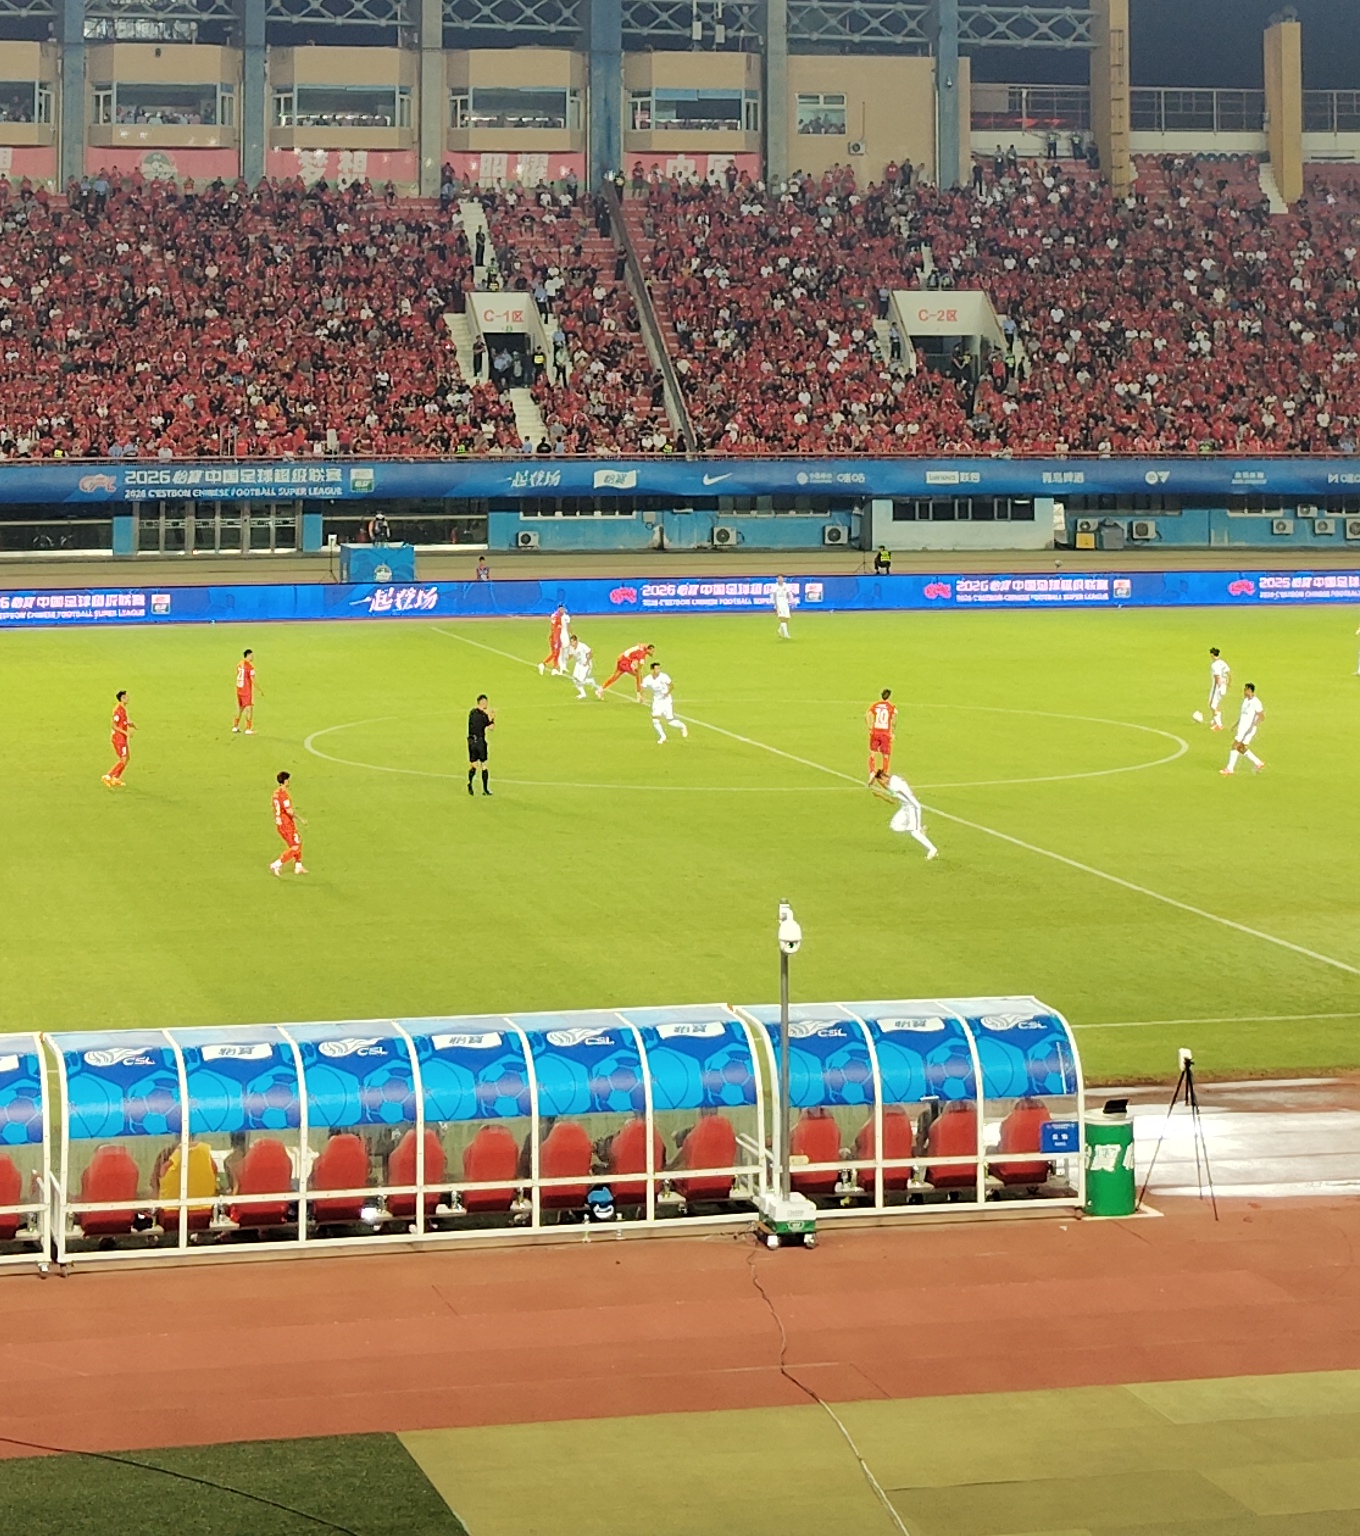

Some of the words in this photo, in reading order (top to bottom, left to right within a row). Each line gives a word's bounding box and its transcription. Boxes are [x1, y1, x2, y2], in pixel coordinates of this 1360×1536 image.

[298, 150, 368, 186] 梦想
[480, 153, 550, 187] 照耀
[484, 310, 524, 322] C-1区
[918, 309, 958, 322] C-2区
[205, 468, 342, 484] 中国足球超级联赛
[230, 488, 276, 497] FOOTBALL
[308, 487, 342, 496] LEAGUE
[700, 583, 799, 595] 中国足球超级赛
[874, 708, 889, 729] 10
[1018, 1021, 1048, 1030] CSL
[817, 1029, 847, 1037] CSL
[585, 1036, 615, 1045] CSL
[357, 1046, 388, 1056] CSL
[123, 1056, 155, 1065] CSL
